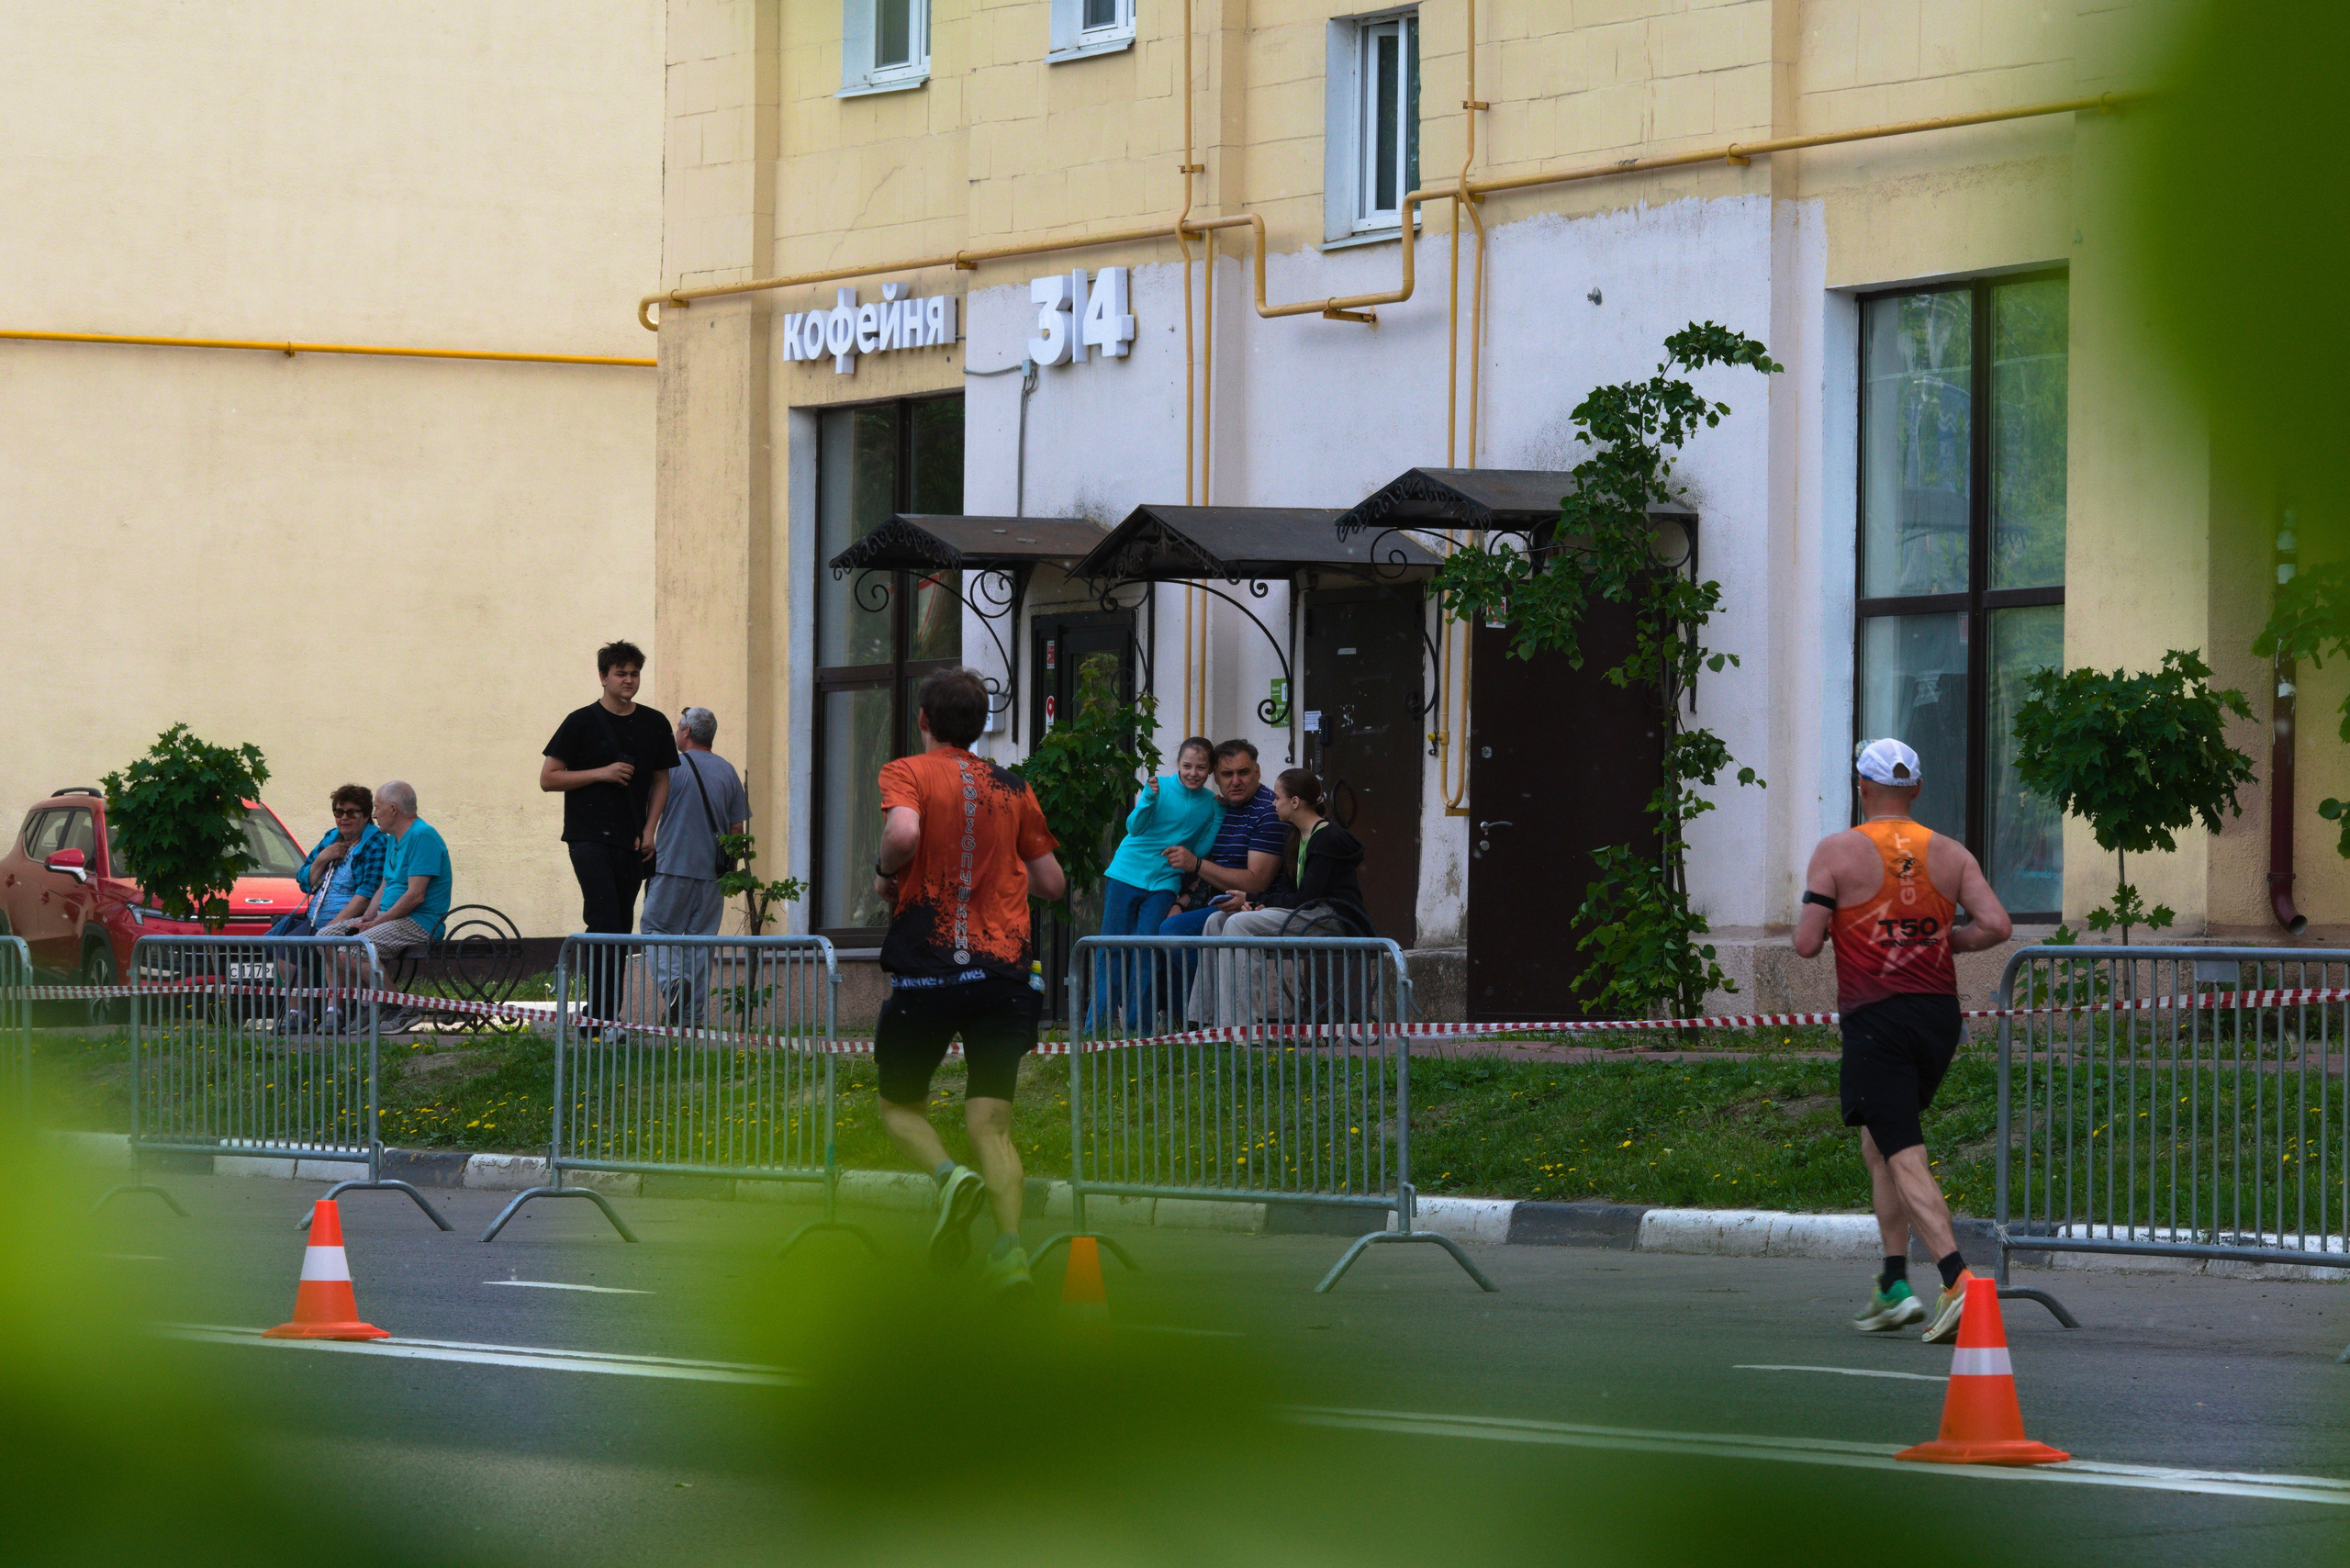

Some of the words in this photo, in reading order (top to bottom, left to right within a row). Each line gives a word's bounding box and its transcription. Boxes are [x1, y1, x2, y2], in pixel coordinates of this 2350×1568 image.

[783, 282, 956, 375] кофейня
[1877, 917, 1939, 937] T50
[1881, 938, 1939, 949] FINISHER
